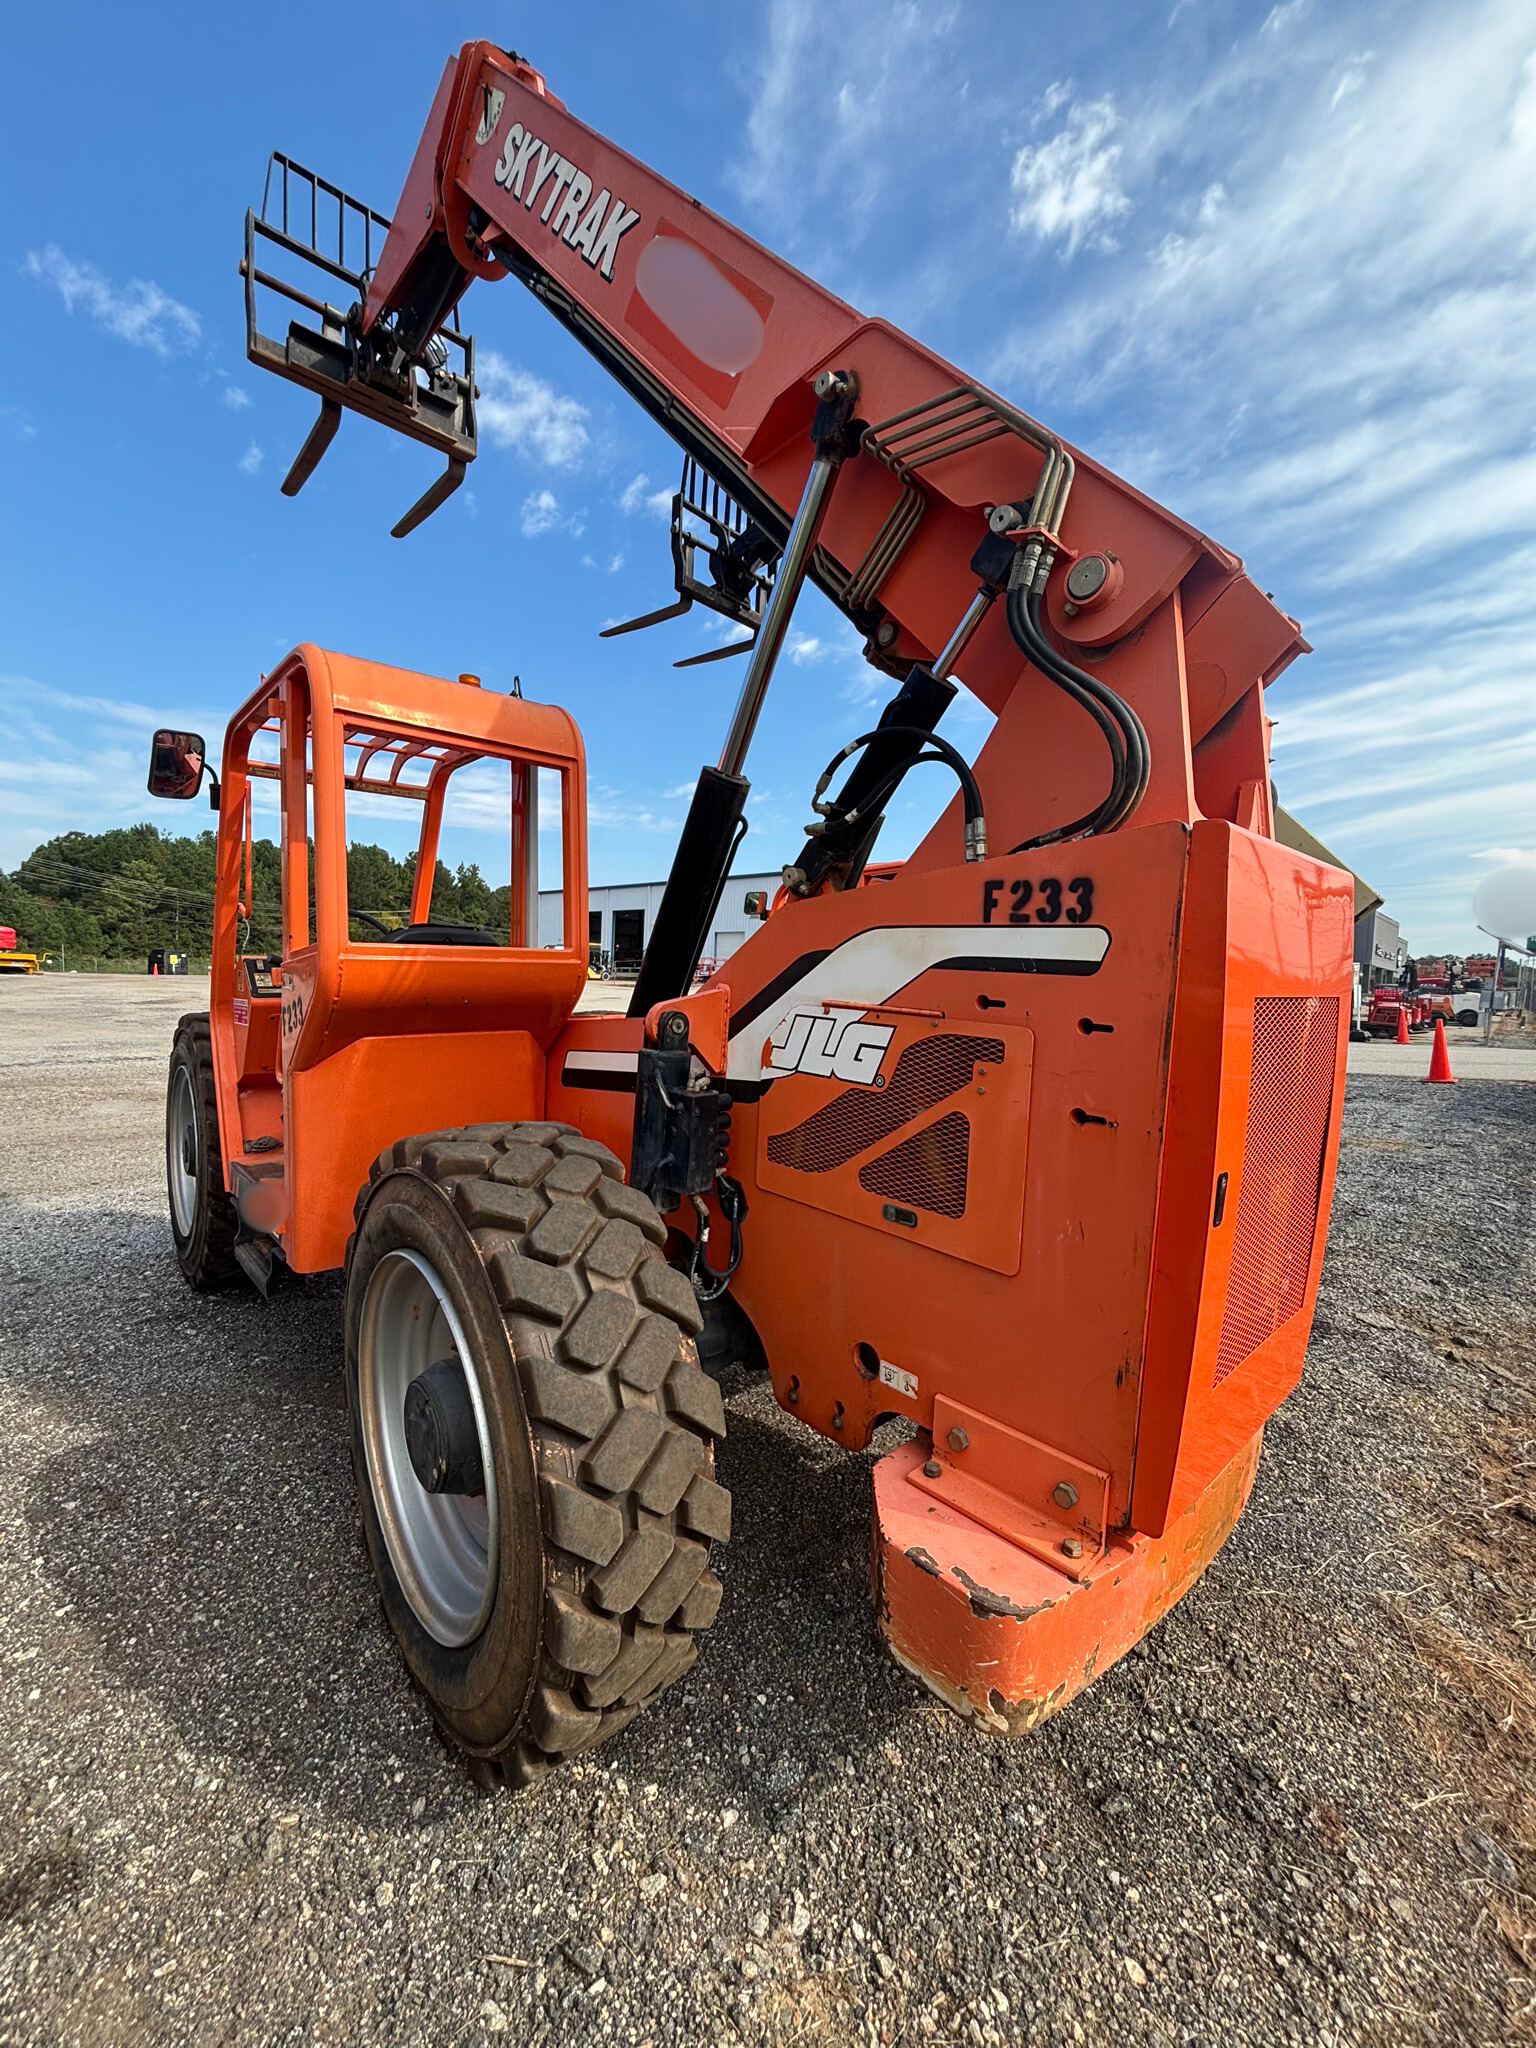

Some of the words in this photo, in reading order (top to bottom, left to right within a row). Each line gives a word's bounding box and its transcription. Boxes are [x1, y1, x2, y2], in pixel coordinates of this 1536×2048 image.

[494, 122, 641, 284] SKYTRAK
[983, 877, 1094, 923] F233
[771, 1013, 898, 1087] JLG
